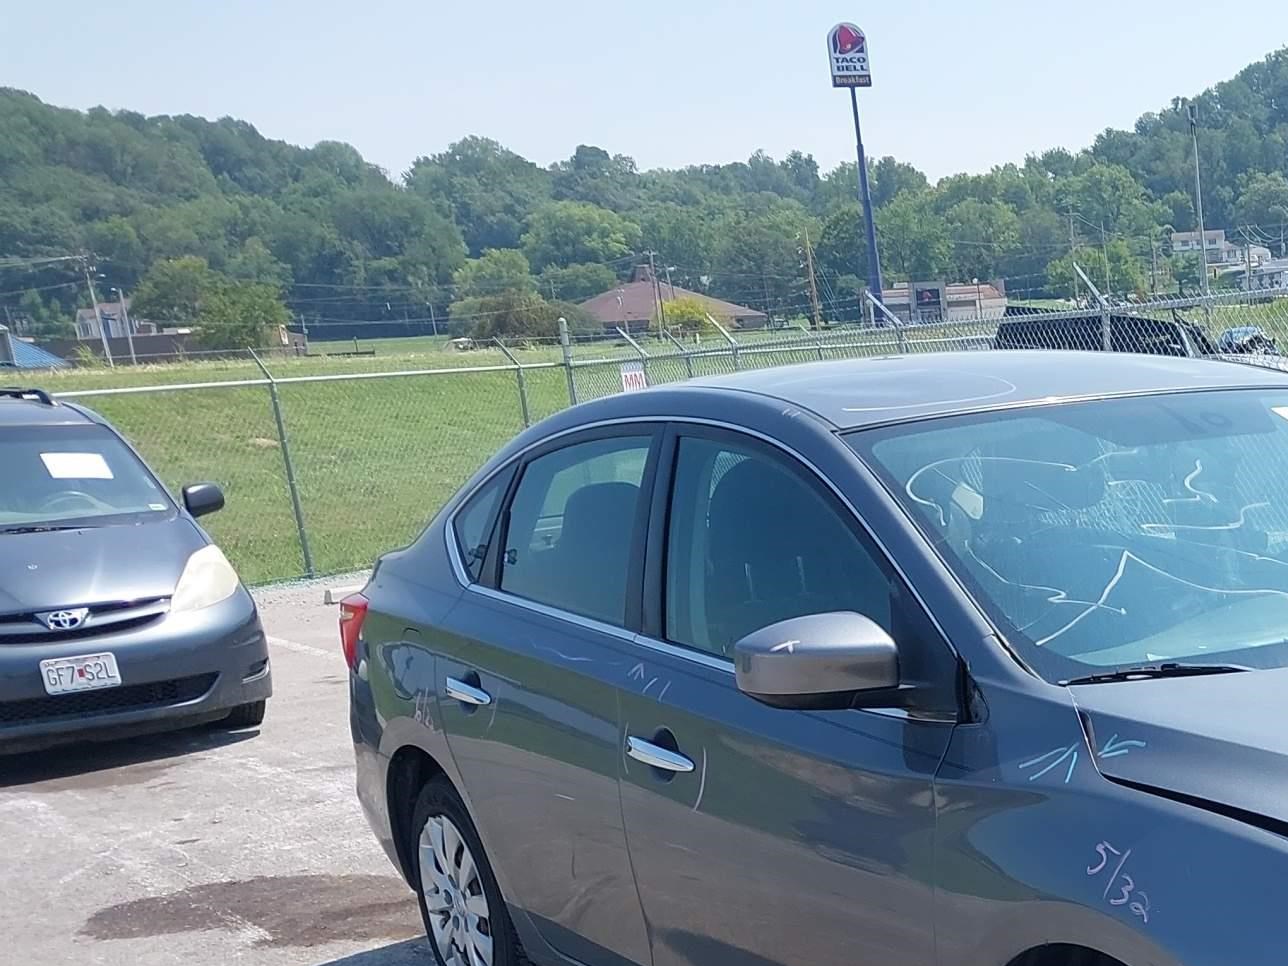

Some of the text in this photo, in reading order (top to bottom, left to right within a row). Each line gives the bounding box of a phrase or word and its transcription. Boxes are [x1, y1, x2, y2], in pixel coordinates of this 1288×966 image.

[833, 56, 866, 64] TACO
[46, 661, 117, 687] GF7 S2L
